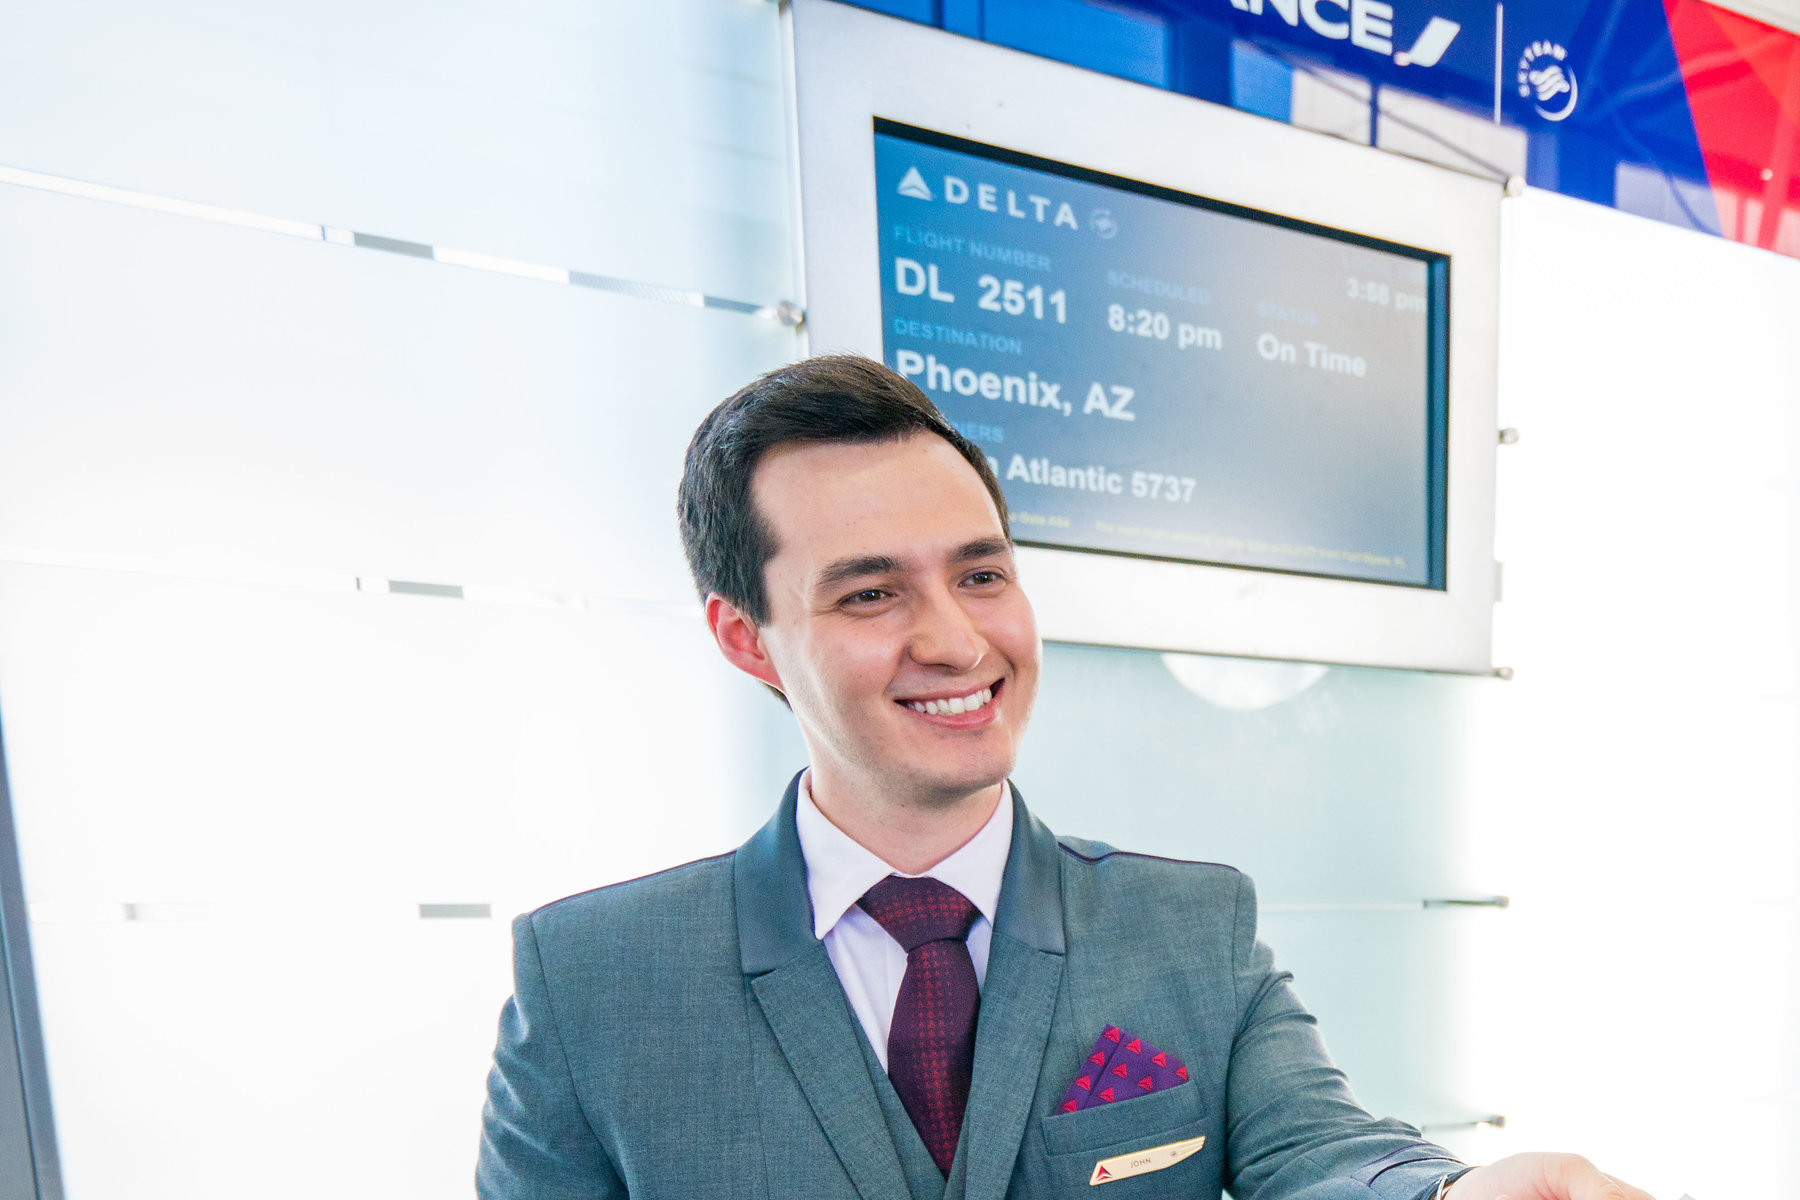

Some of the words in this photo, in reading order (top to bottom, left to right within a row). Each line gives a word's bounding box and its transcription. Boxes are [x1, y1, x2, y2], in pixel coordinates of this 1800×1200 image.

[944, 174, 1079, 231] DELTA
[893, 225, 966, 254] FLIGHT
[969, 240, 1052, 272] NUMBER
[894, 256, 956, 304] DL
[977, 273, 1068, 325] 2511
[1106, 271, 1212, 306] SCHEDULED
[892, 317, 1023, 356] DESTINATION
[1107, 303, 1170, 341] 8:20
[1178, 321, 1222, 351] pm
[1256, 331, 1297, 365] On
[1302, 340, 1368, 379] Time
[896, 348, 1073, 418] Phoenix,
[1082, 381, 1137, 423] AZ
[1006, 453, 1125, 496] Atlantic
[1130, 469, 1198, 504] 5737
[1130, 1158, 1152, 1169] JOHN
